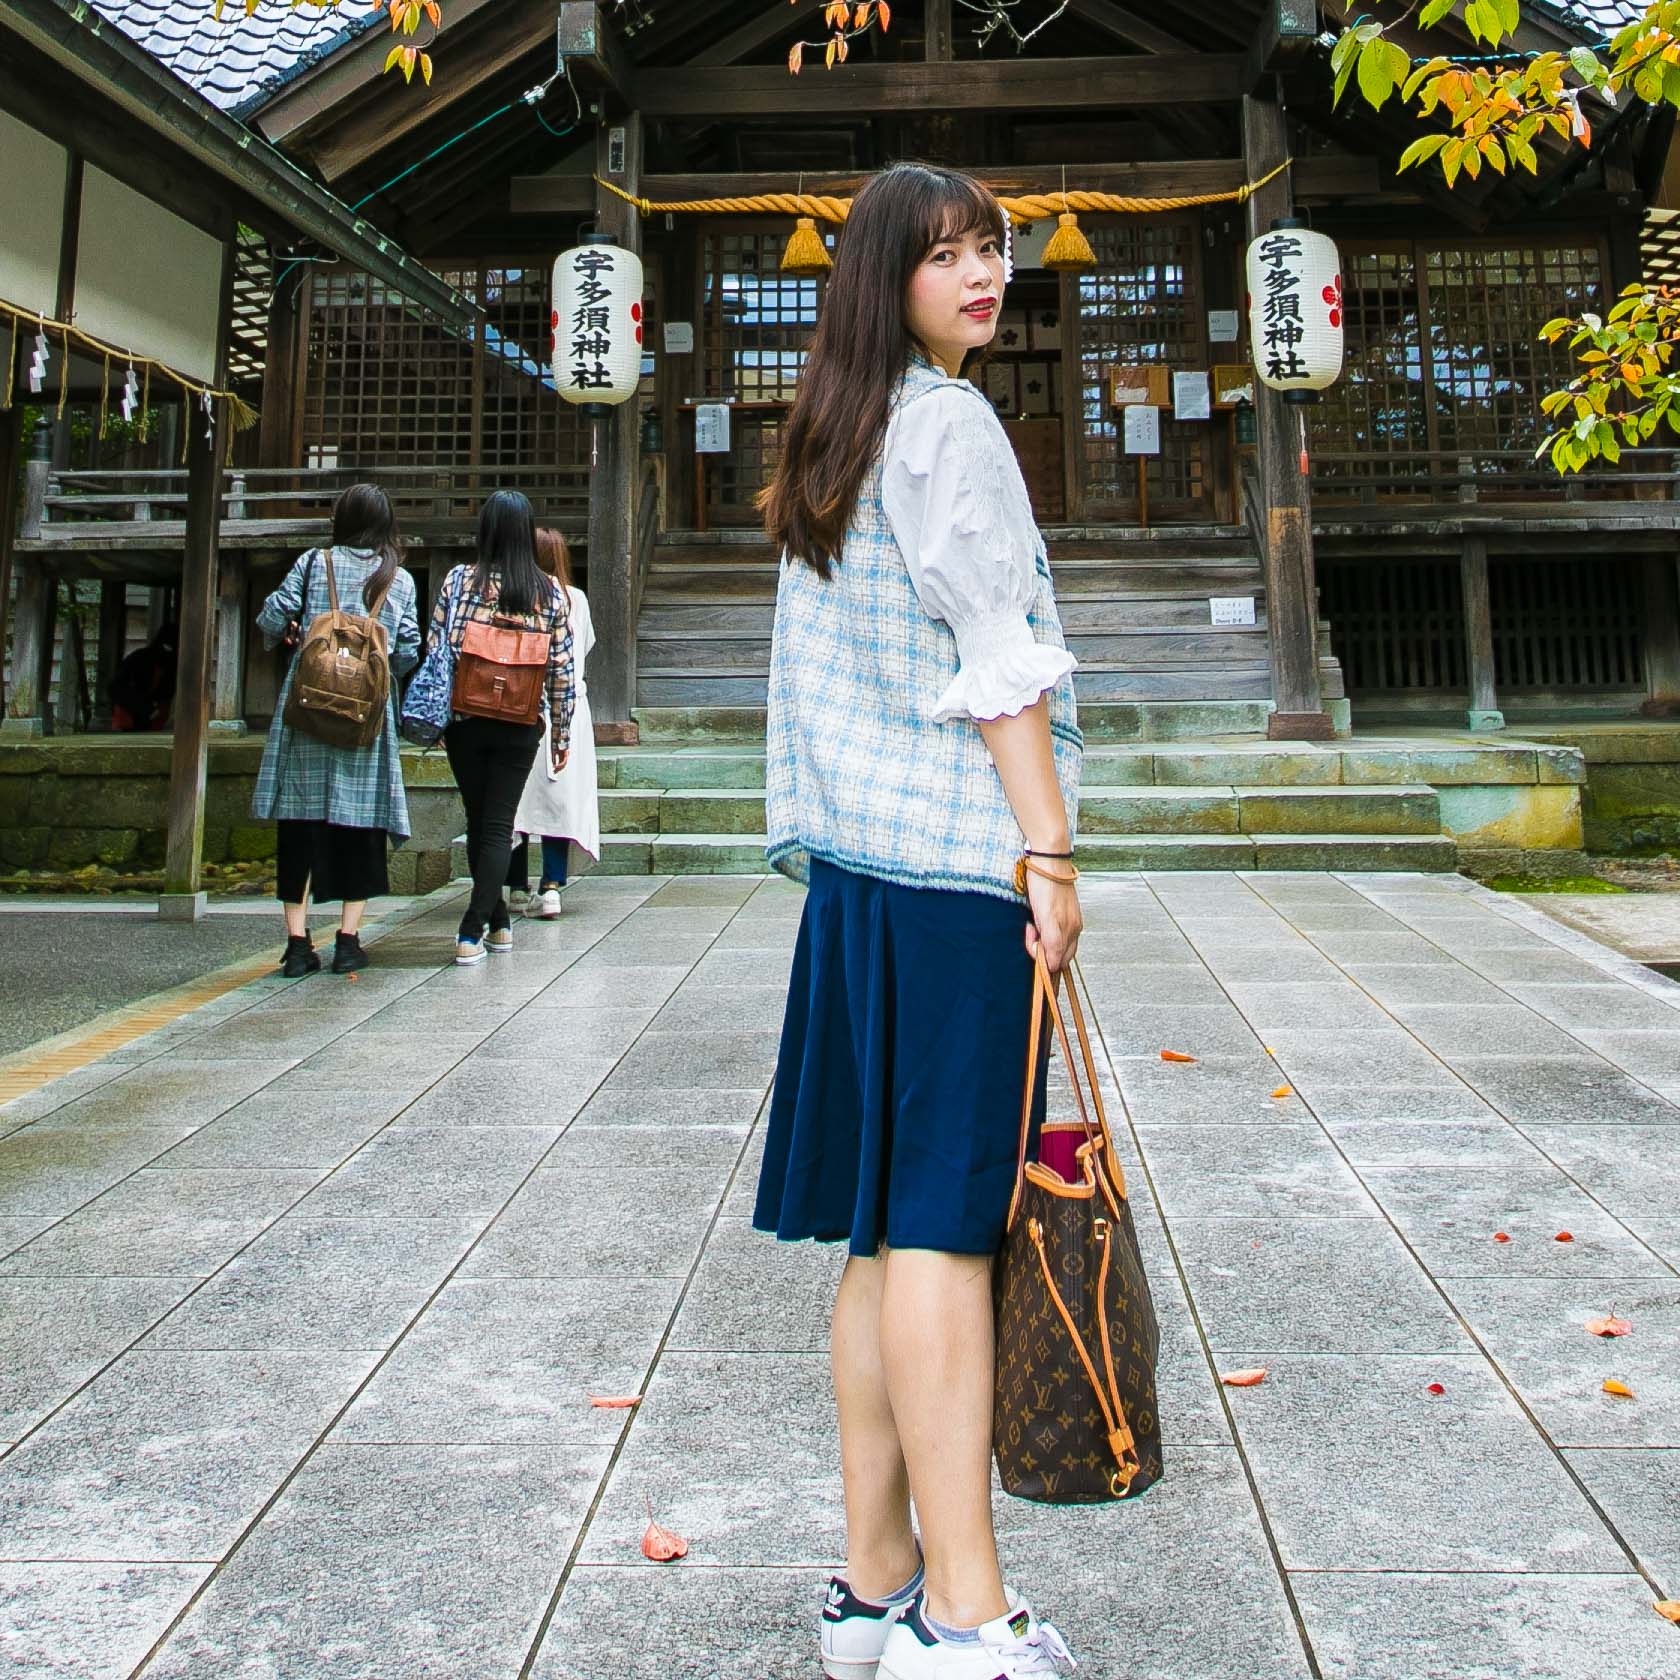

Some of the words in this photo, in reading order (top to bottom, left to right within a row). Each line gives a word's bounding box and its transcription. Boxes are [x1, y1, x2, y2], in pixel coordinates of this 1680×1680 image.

[569, 250, 614, 390] 宇多須神社
[1259, 235, 1311, 381] 宇多須神社
